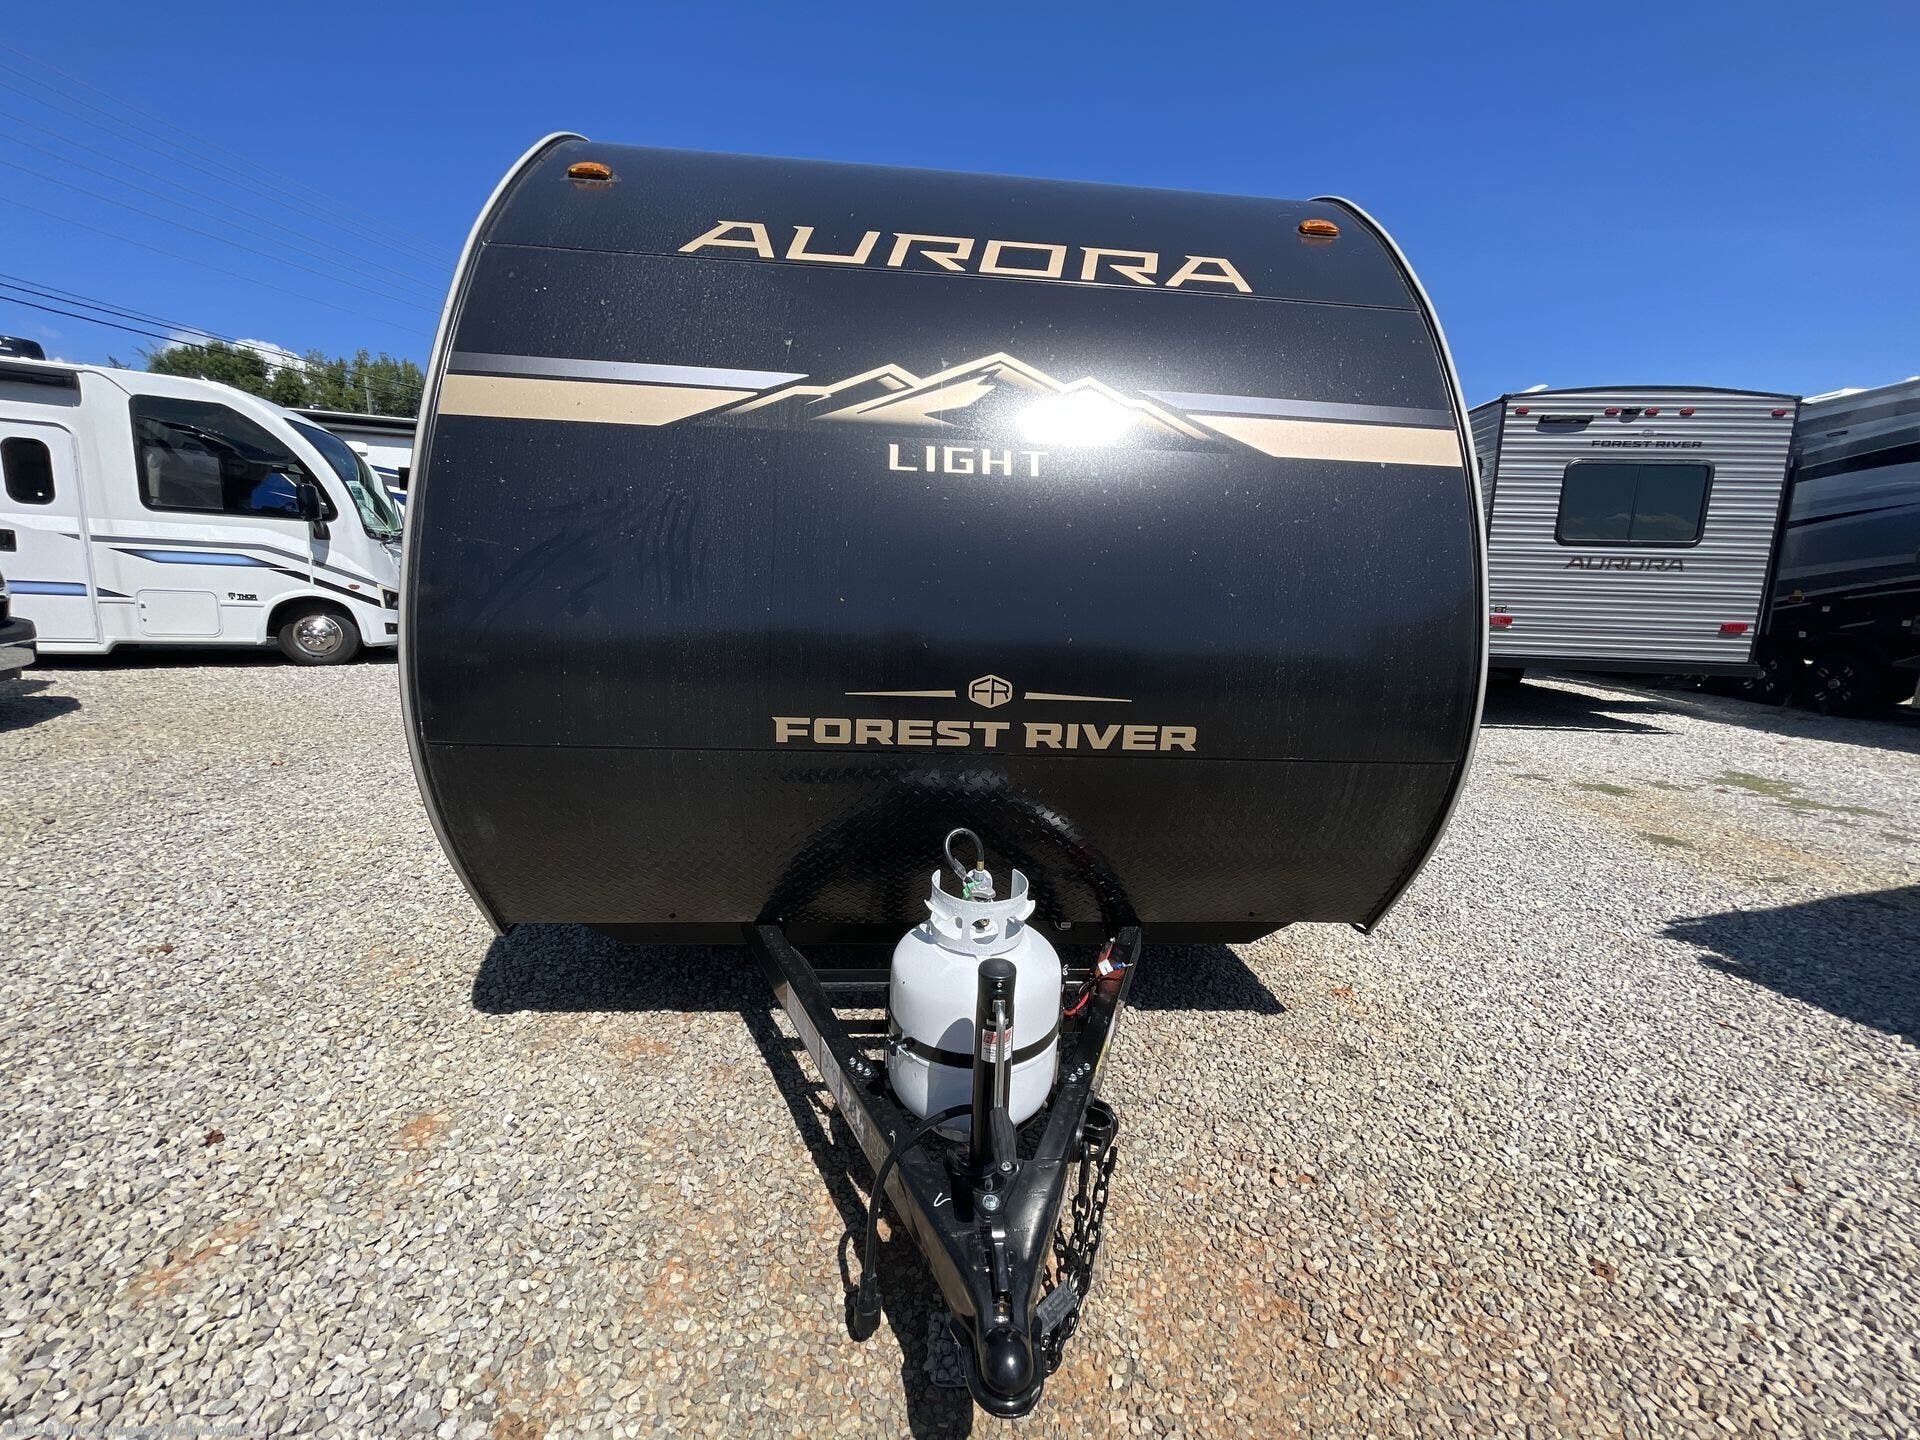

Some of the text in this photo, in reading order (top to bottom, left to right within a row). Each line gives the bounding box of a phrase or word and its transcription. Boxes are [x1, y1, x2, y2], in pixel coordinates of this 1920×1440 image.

[678, 219, 1253, 293] AURORA
[1591, 440, 1653, 448] FOREST
[888, 443, 1048, 478] LIGHT
[1563, 556, 1684, 571] AURORA
[237, 593, 258, 601] THOR
[771, 716, 1198, 752] FOREST RIVER
